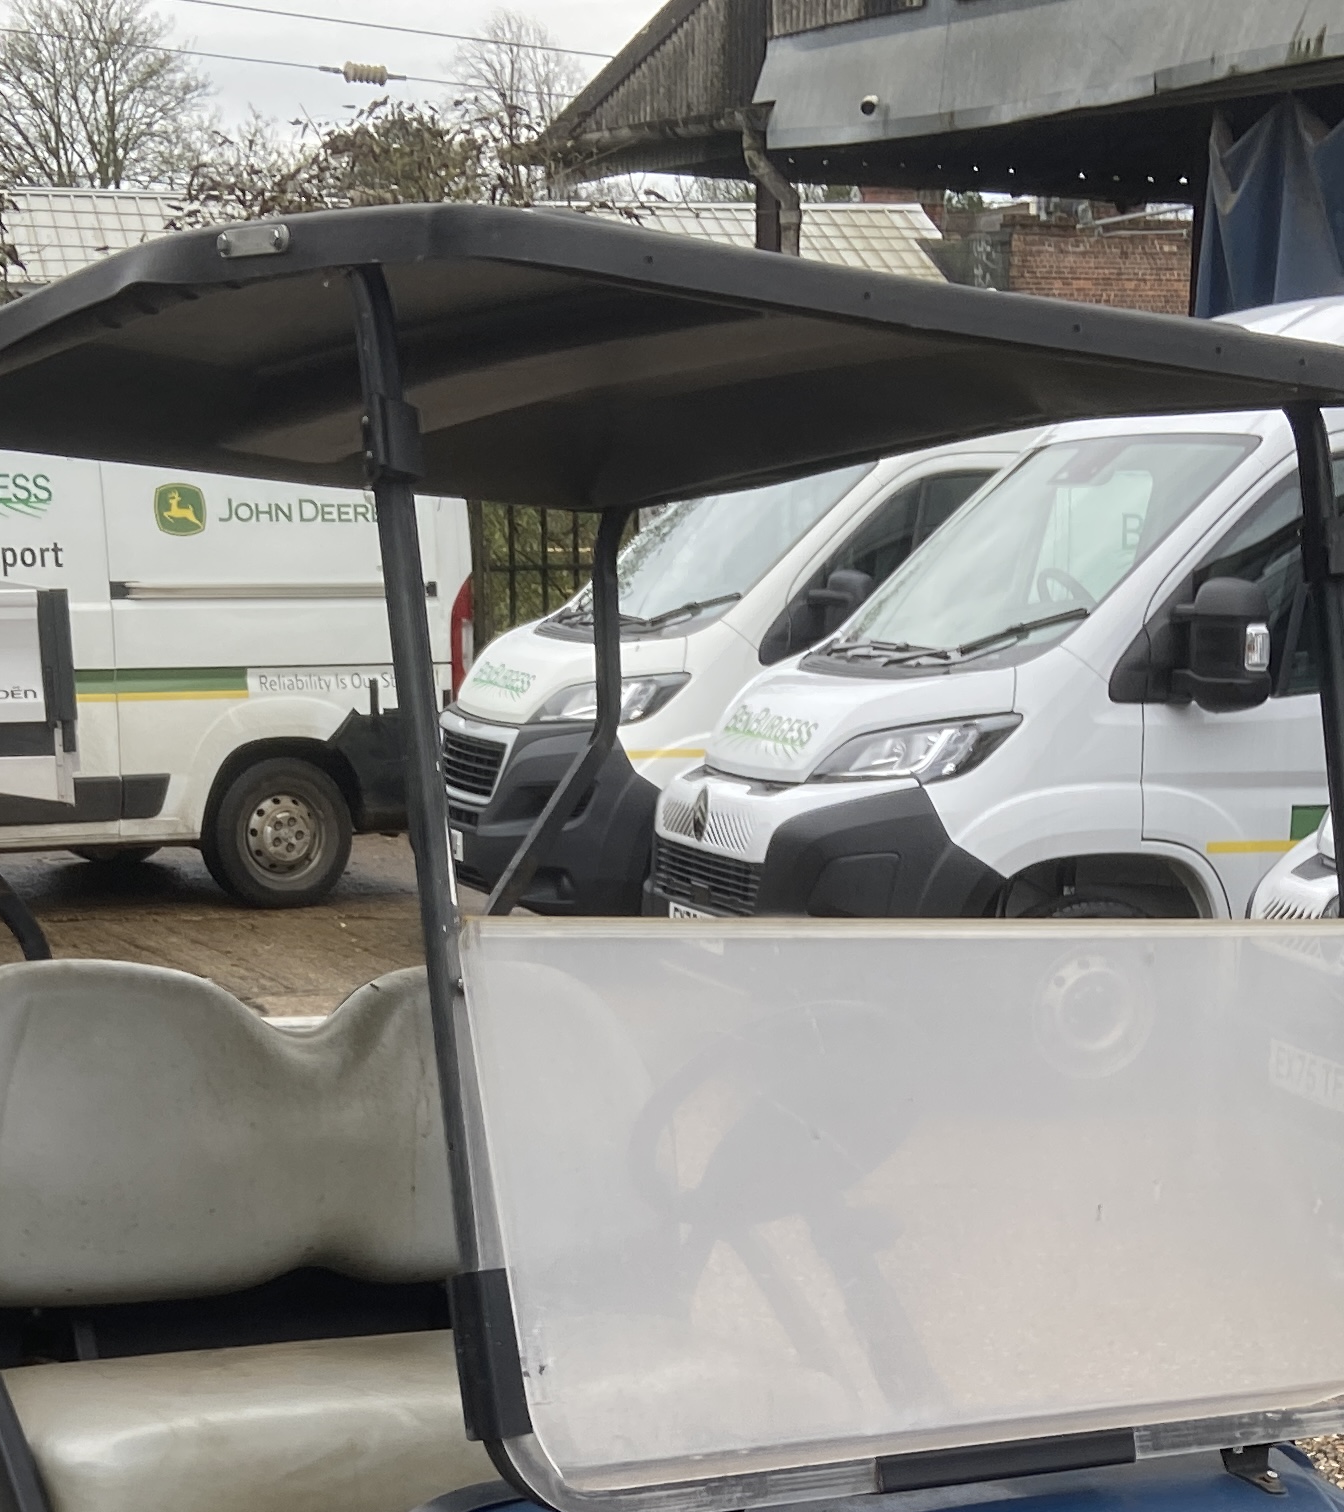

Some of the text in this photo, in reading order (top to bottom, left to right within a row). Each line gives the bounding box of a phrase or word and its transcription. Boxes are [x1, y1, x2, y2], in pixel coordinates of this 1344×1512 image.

[219, 498, 293, 522] JOHN
[258, 674, 332, 693] Reliability
[337, 673, 348, 689] Is
